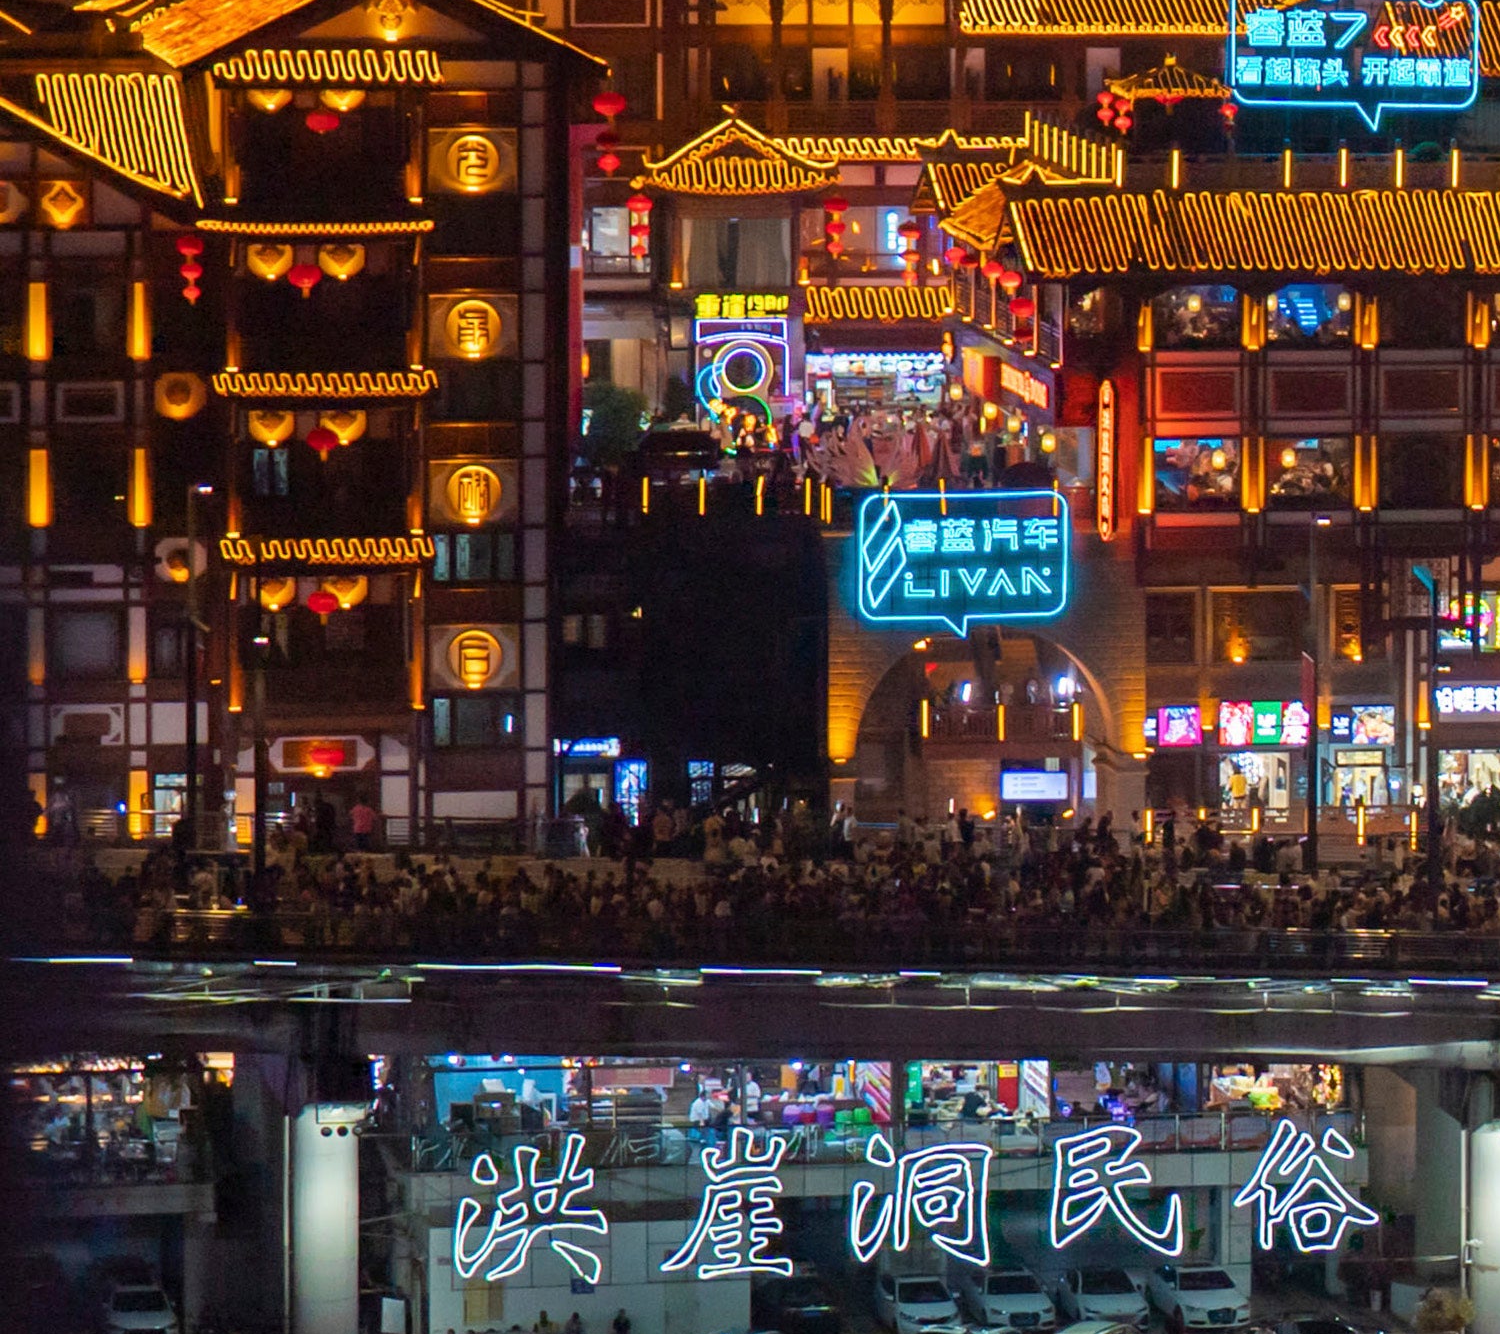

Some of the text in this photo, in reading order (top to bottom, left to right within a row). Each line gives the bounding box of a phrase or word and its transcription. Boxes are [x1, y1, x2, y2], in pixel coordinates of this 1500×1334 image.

[1246, 8, 1367, 50] 睿蓝7
[905, 517, 1059, 554] 睿蓝汽车
[905, 567, 1055, 598] LIVAN
